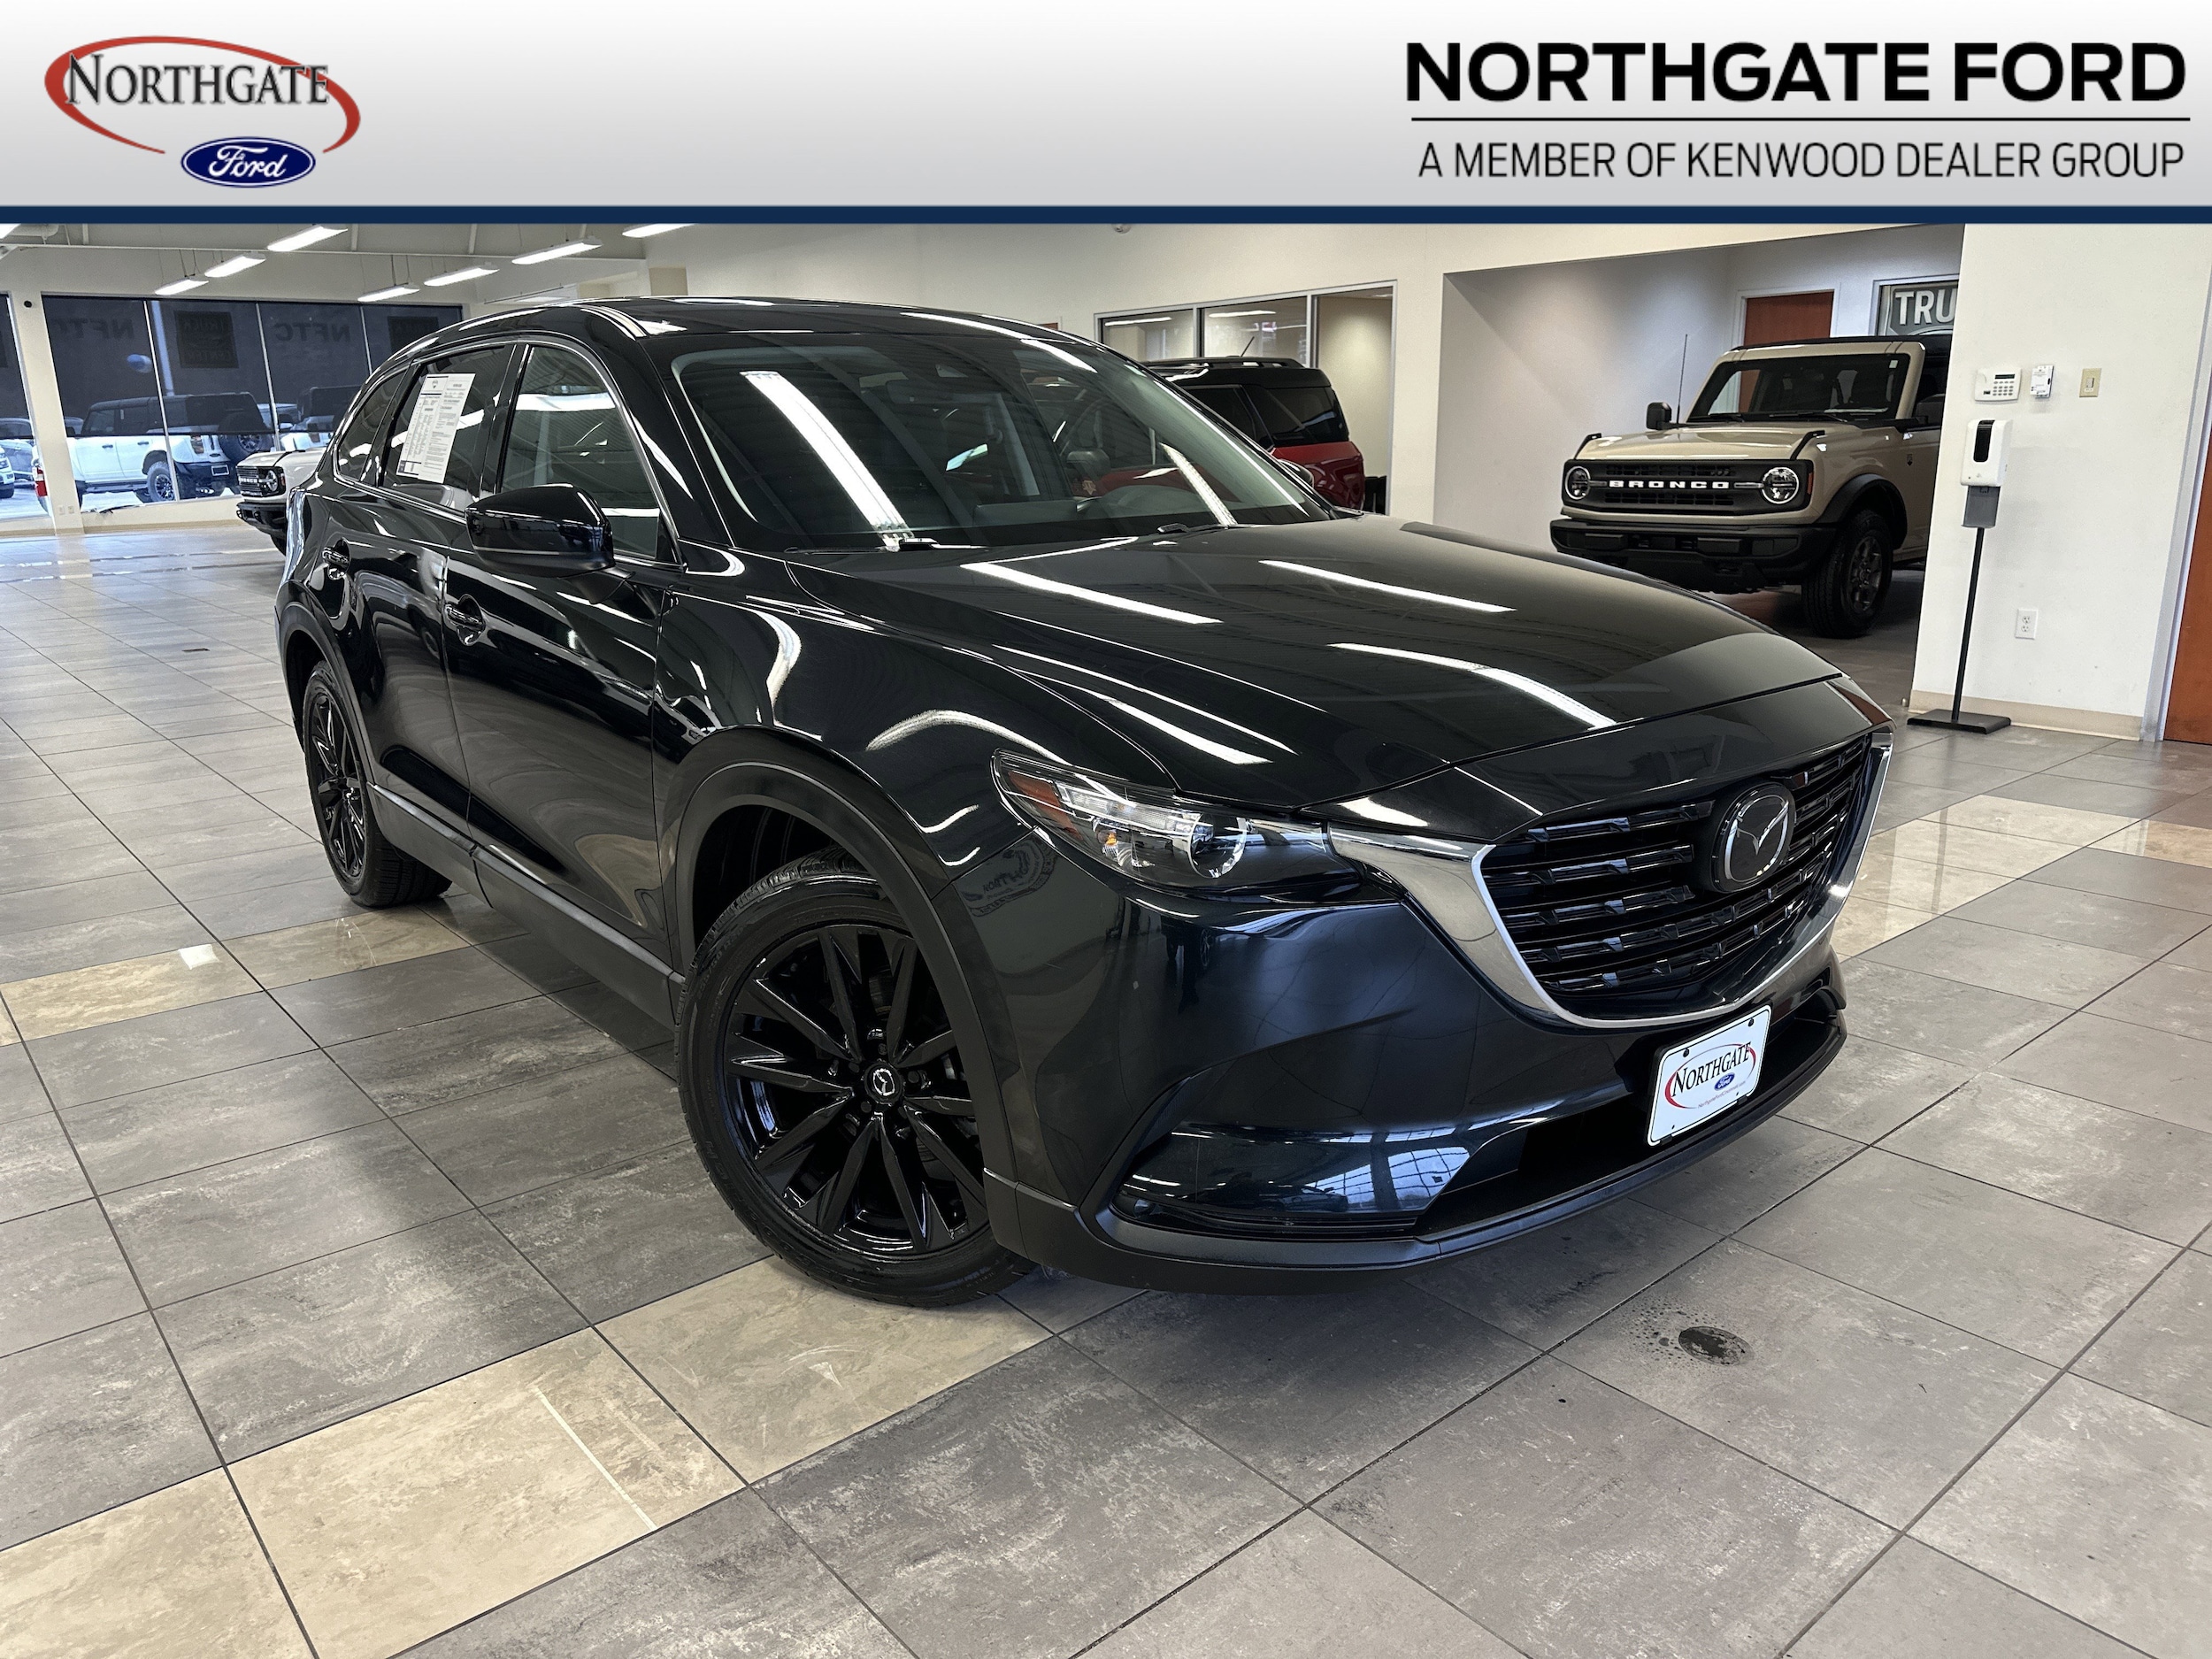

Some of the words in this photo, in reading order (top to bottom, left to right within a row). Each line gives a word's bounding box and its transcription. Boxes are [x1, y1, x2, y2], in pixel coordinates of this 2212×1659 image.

[1894, 288, 1958, 326] TRU
[1609, 480, 1730, 489] BRONCO
[1671, 1041, 1752, 1097] NORTHGATE
